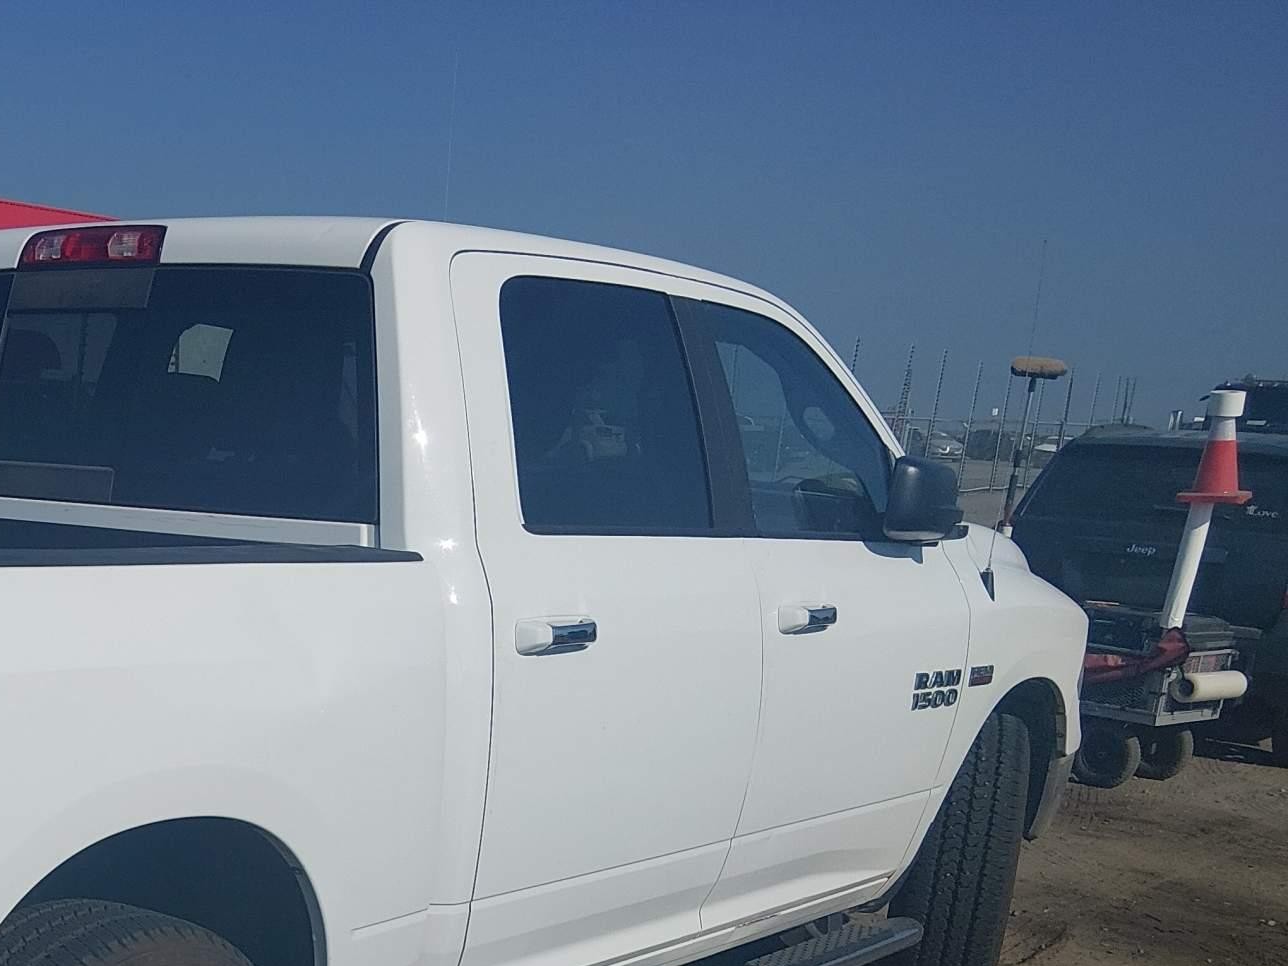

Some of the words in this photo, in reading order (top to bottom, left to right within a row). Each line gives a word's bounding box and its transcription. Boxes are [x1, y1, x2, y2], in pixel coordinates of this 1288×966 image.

[1126, 544, 1156, 556] Jeep
[914, 669, 962, 690] RAM
[911, 688, 958, 711] 1500
